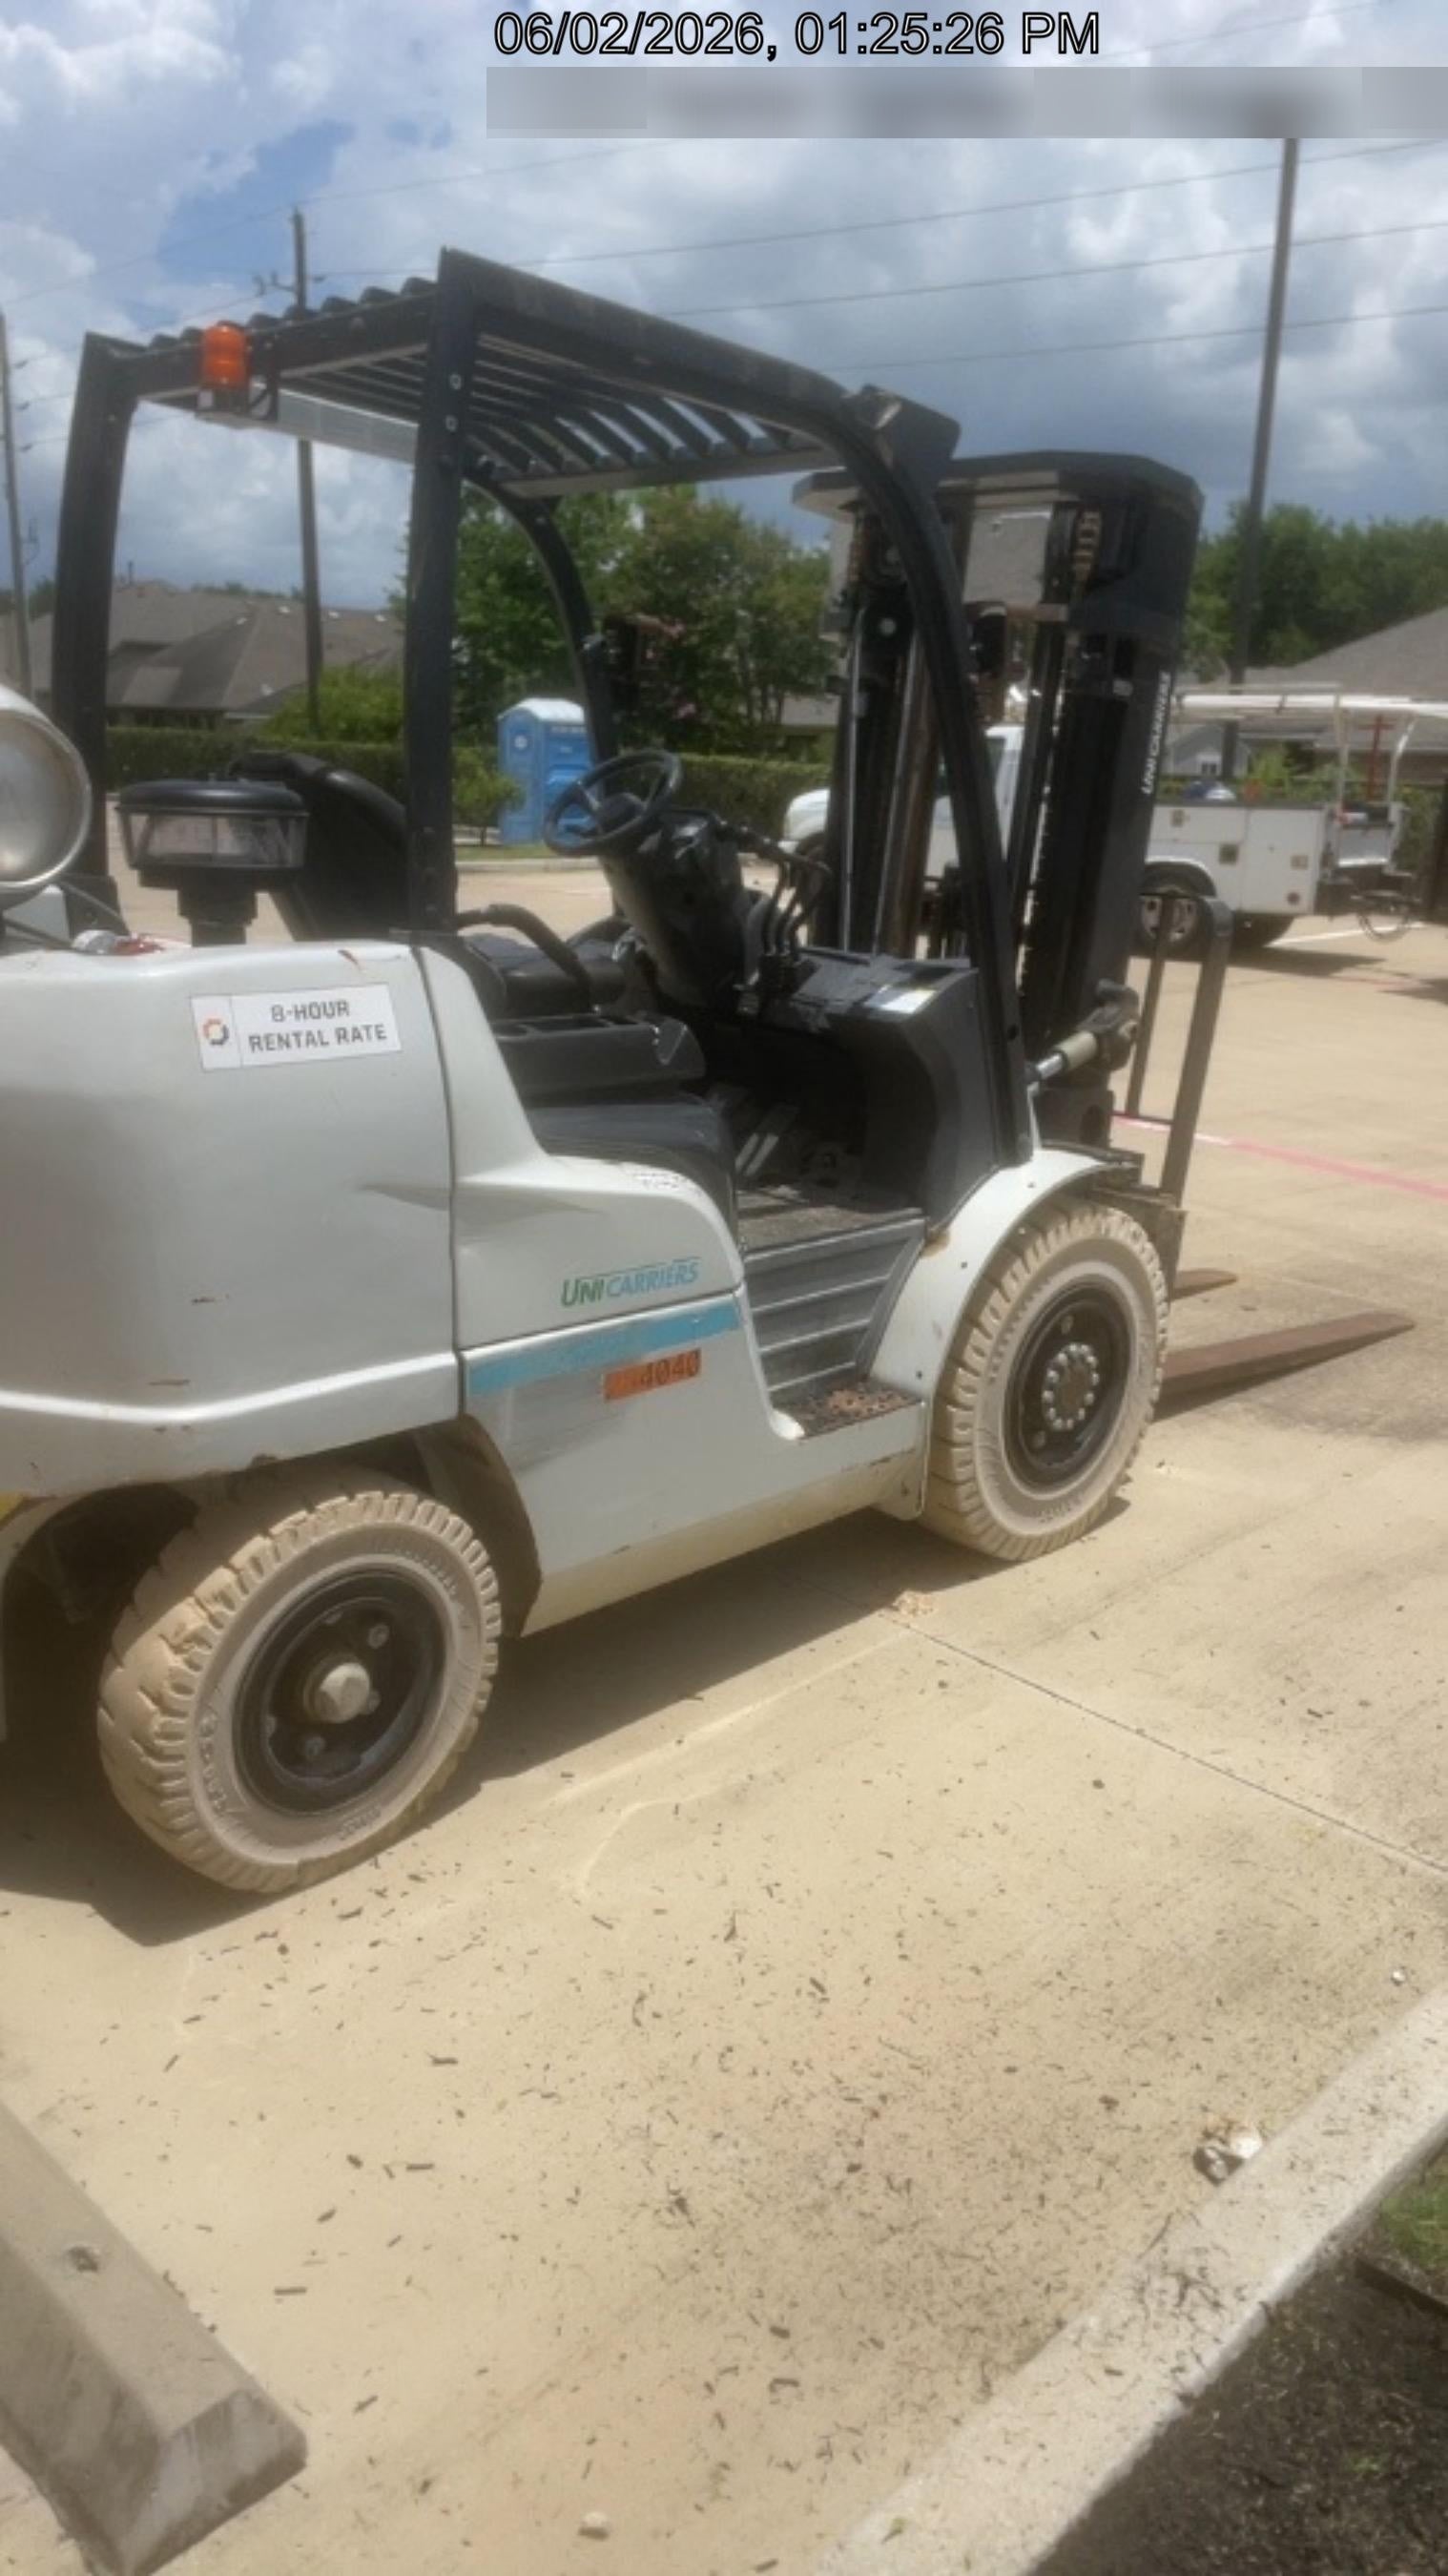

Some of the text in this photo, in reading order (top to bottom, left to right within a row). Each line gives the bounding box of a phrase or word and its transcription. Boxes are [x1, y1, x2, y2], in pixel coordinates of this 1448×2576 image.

[271, 1001, 350, 1022] 8-HOUR
[249, 1025, 387, 1052] RENTAL RATE
